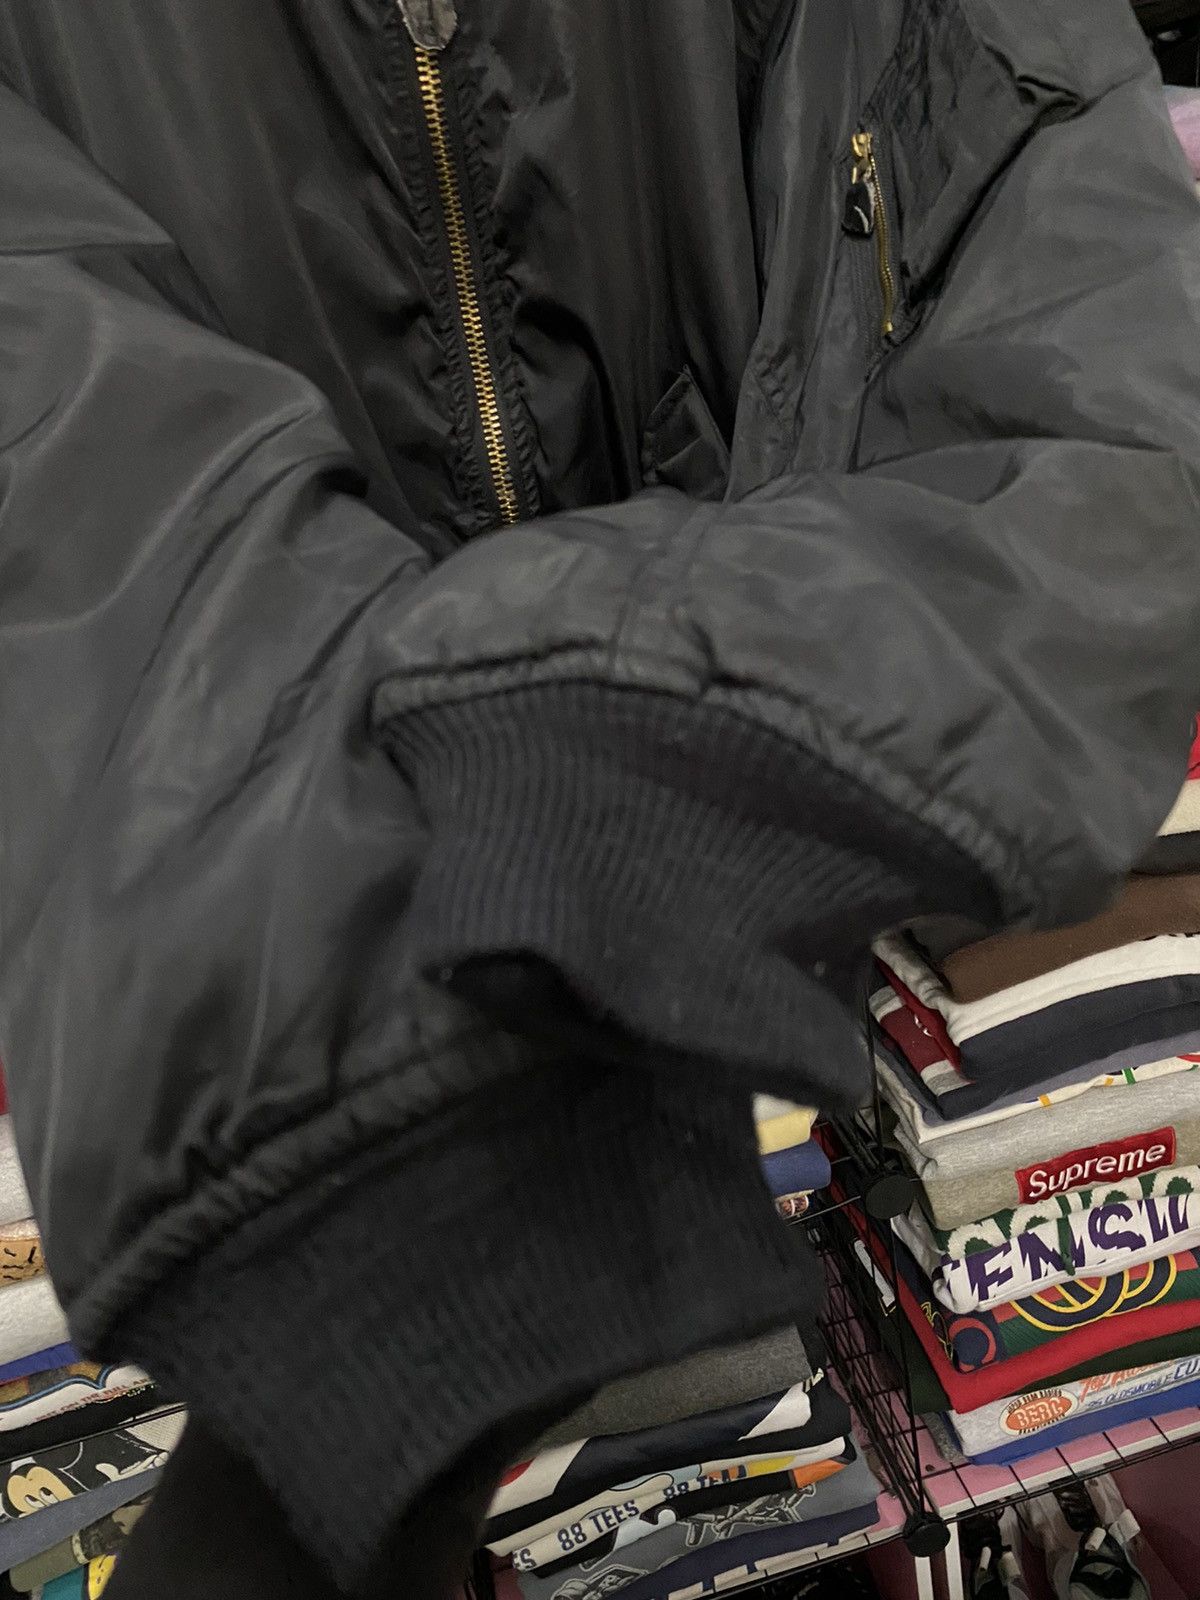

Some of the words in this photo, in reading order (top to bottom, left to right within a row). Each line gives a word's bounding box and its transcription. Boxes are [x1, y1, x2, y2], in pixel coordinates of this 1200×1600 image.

[1029, 1144, 1166, 1198] Supreme
[1105, 1373, 1174, 1402] OLDSMOBILE
[557, 1522, 587, 1552] 88
[589, 1499, 640, 1534] TEES
